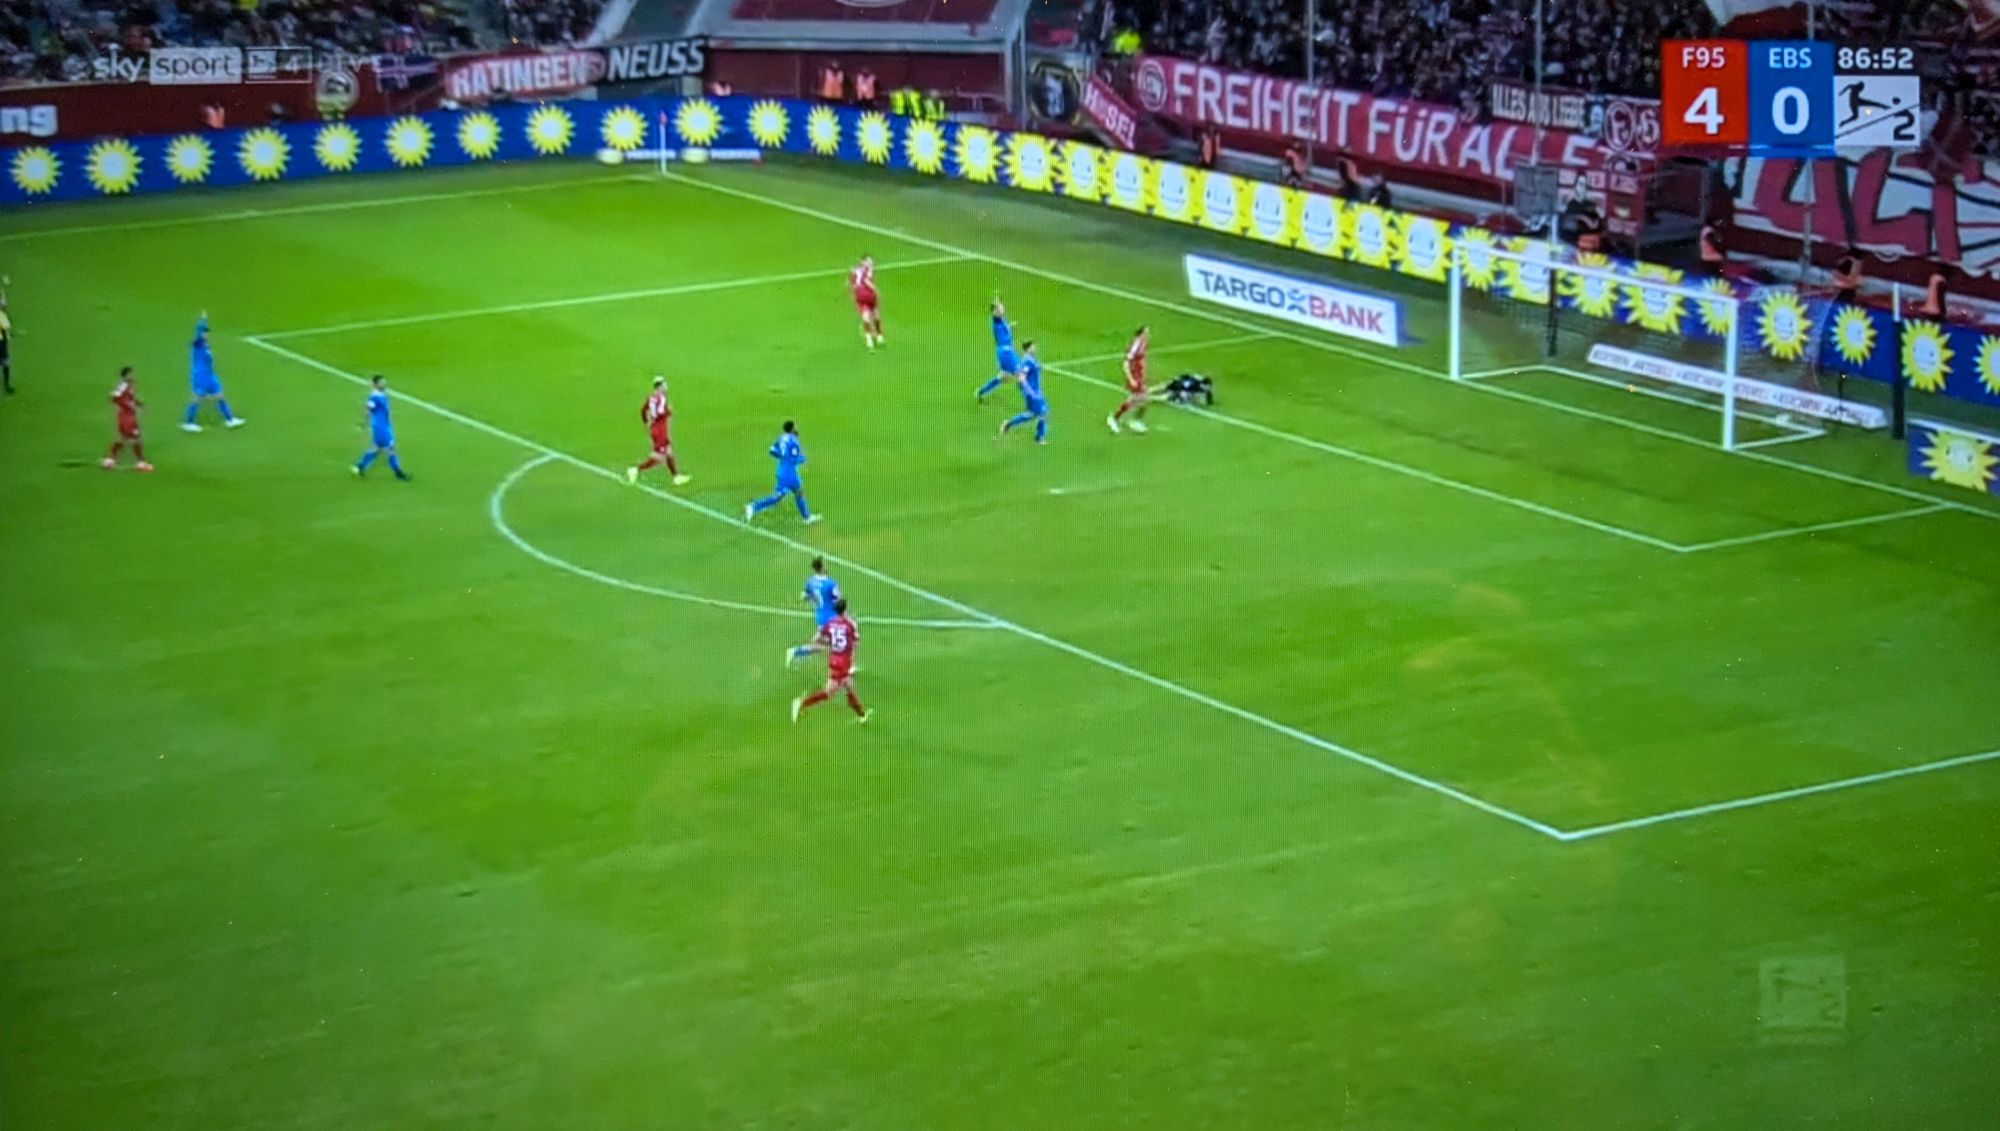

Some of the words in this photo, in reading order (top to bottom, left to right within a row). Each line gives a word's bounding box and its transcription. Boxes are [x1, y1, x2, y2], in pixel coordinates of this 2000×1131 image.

[453, 54, 588, 97] RATINGEN
[607, 40, 705, 81] NEUSS
[1173, 64, 1361, 147] FREIHEIT
[1366, 100, 1457, 166] FÜR
[829, 627, 848, 650] 15
